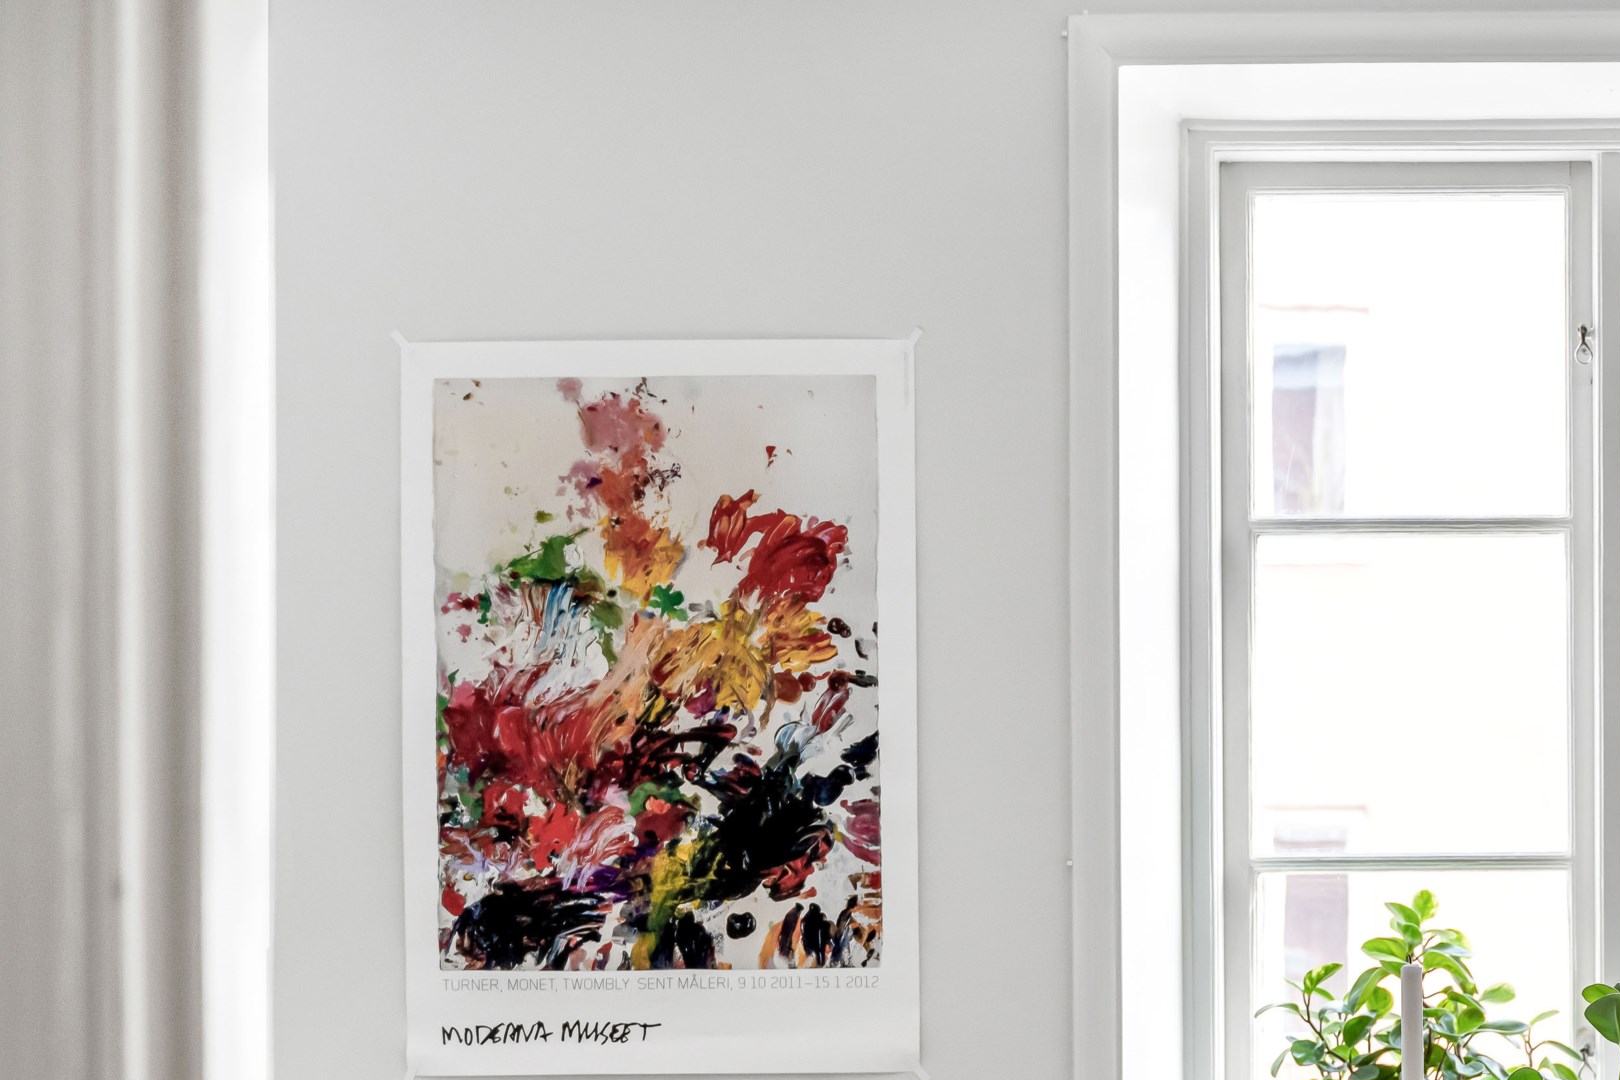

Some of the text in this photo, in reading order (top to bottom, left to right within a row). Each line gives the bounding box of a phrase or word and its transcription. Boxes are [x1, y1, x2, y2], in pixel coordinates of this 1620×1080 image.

[442, 977, 503, 993] TURNER,
[507, 977, 558, 993] MONET,
[563, 976, 631, 991] TWOMBLY
[637, 976, 674, 990] SENT
[677, 974, 734, 992] MÅLERI,
[737, 976, 747, 989] 9
[751, 976, 766, 989] 10
[834, 976, 842, 988] 1
[846, 975, 880, 988] 2012
[441, 1019, 662, 1046] MODERNA MUSEET
